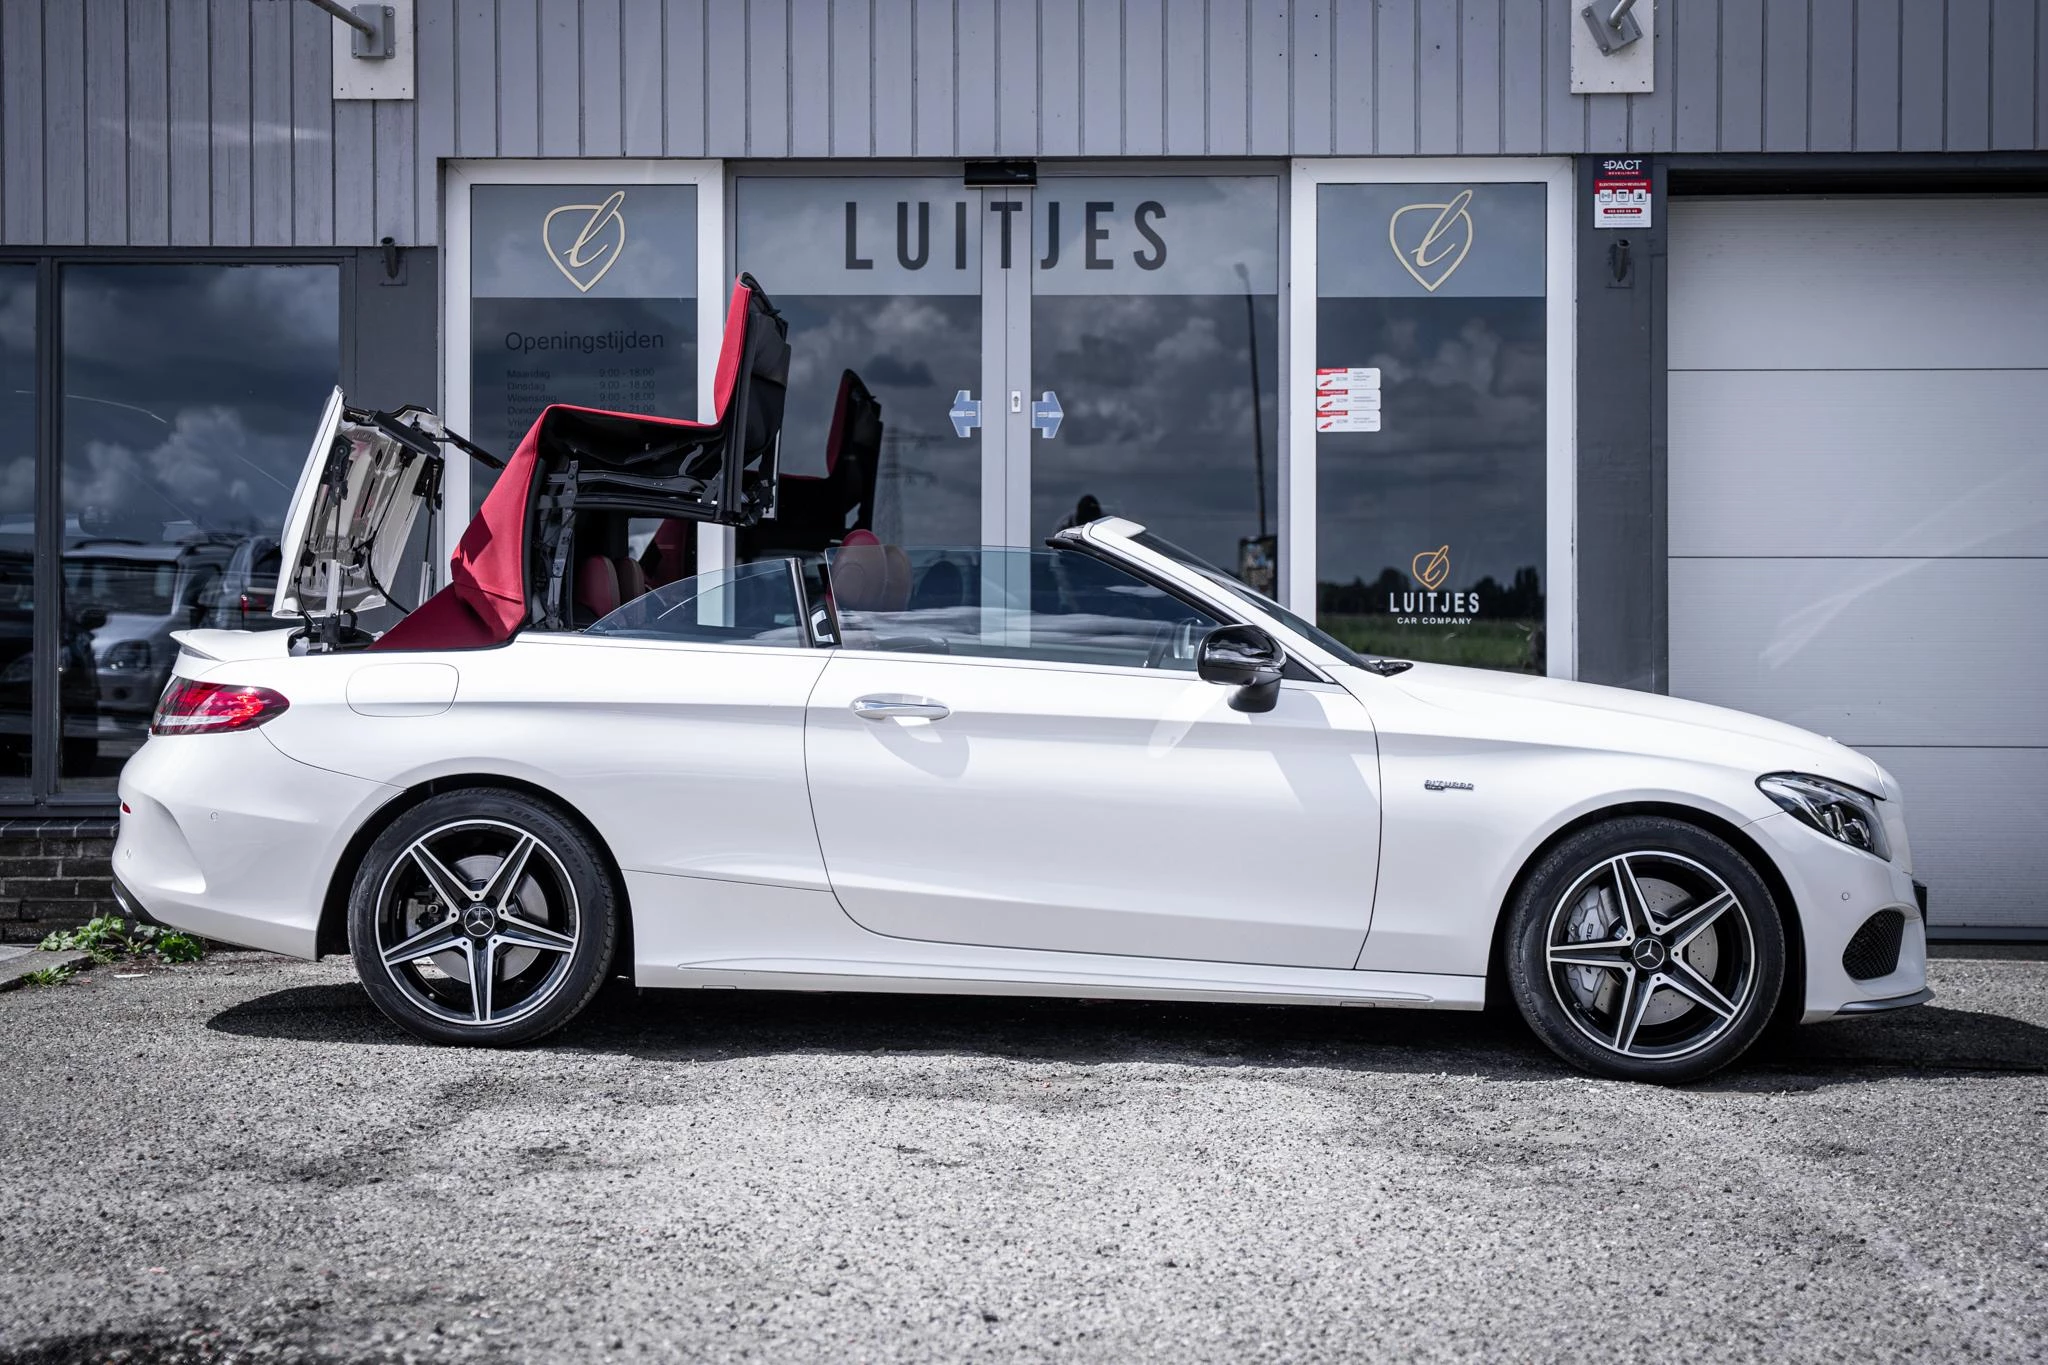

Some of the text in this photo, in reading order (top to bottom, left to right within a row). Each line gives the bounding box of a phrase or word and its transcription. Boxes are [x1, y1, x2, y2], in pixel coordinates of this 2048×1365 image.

[845, 200, 1167, 271] LUITJES
[505, 331, 664, 354] Openingstijden
[507, 368, 550, 379] Maandag
[507, 382, 545, 392] Dinsdag
[1389, 592, 1480, 613] LUITJES
